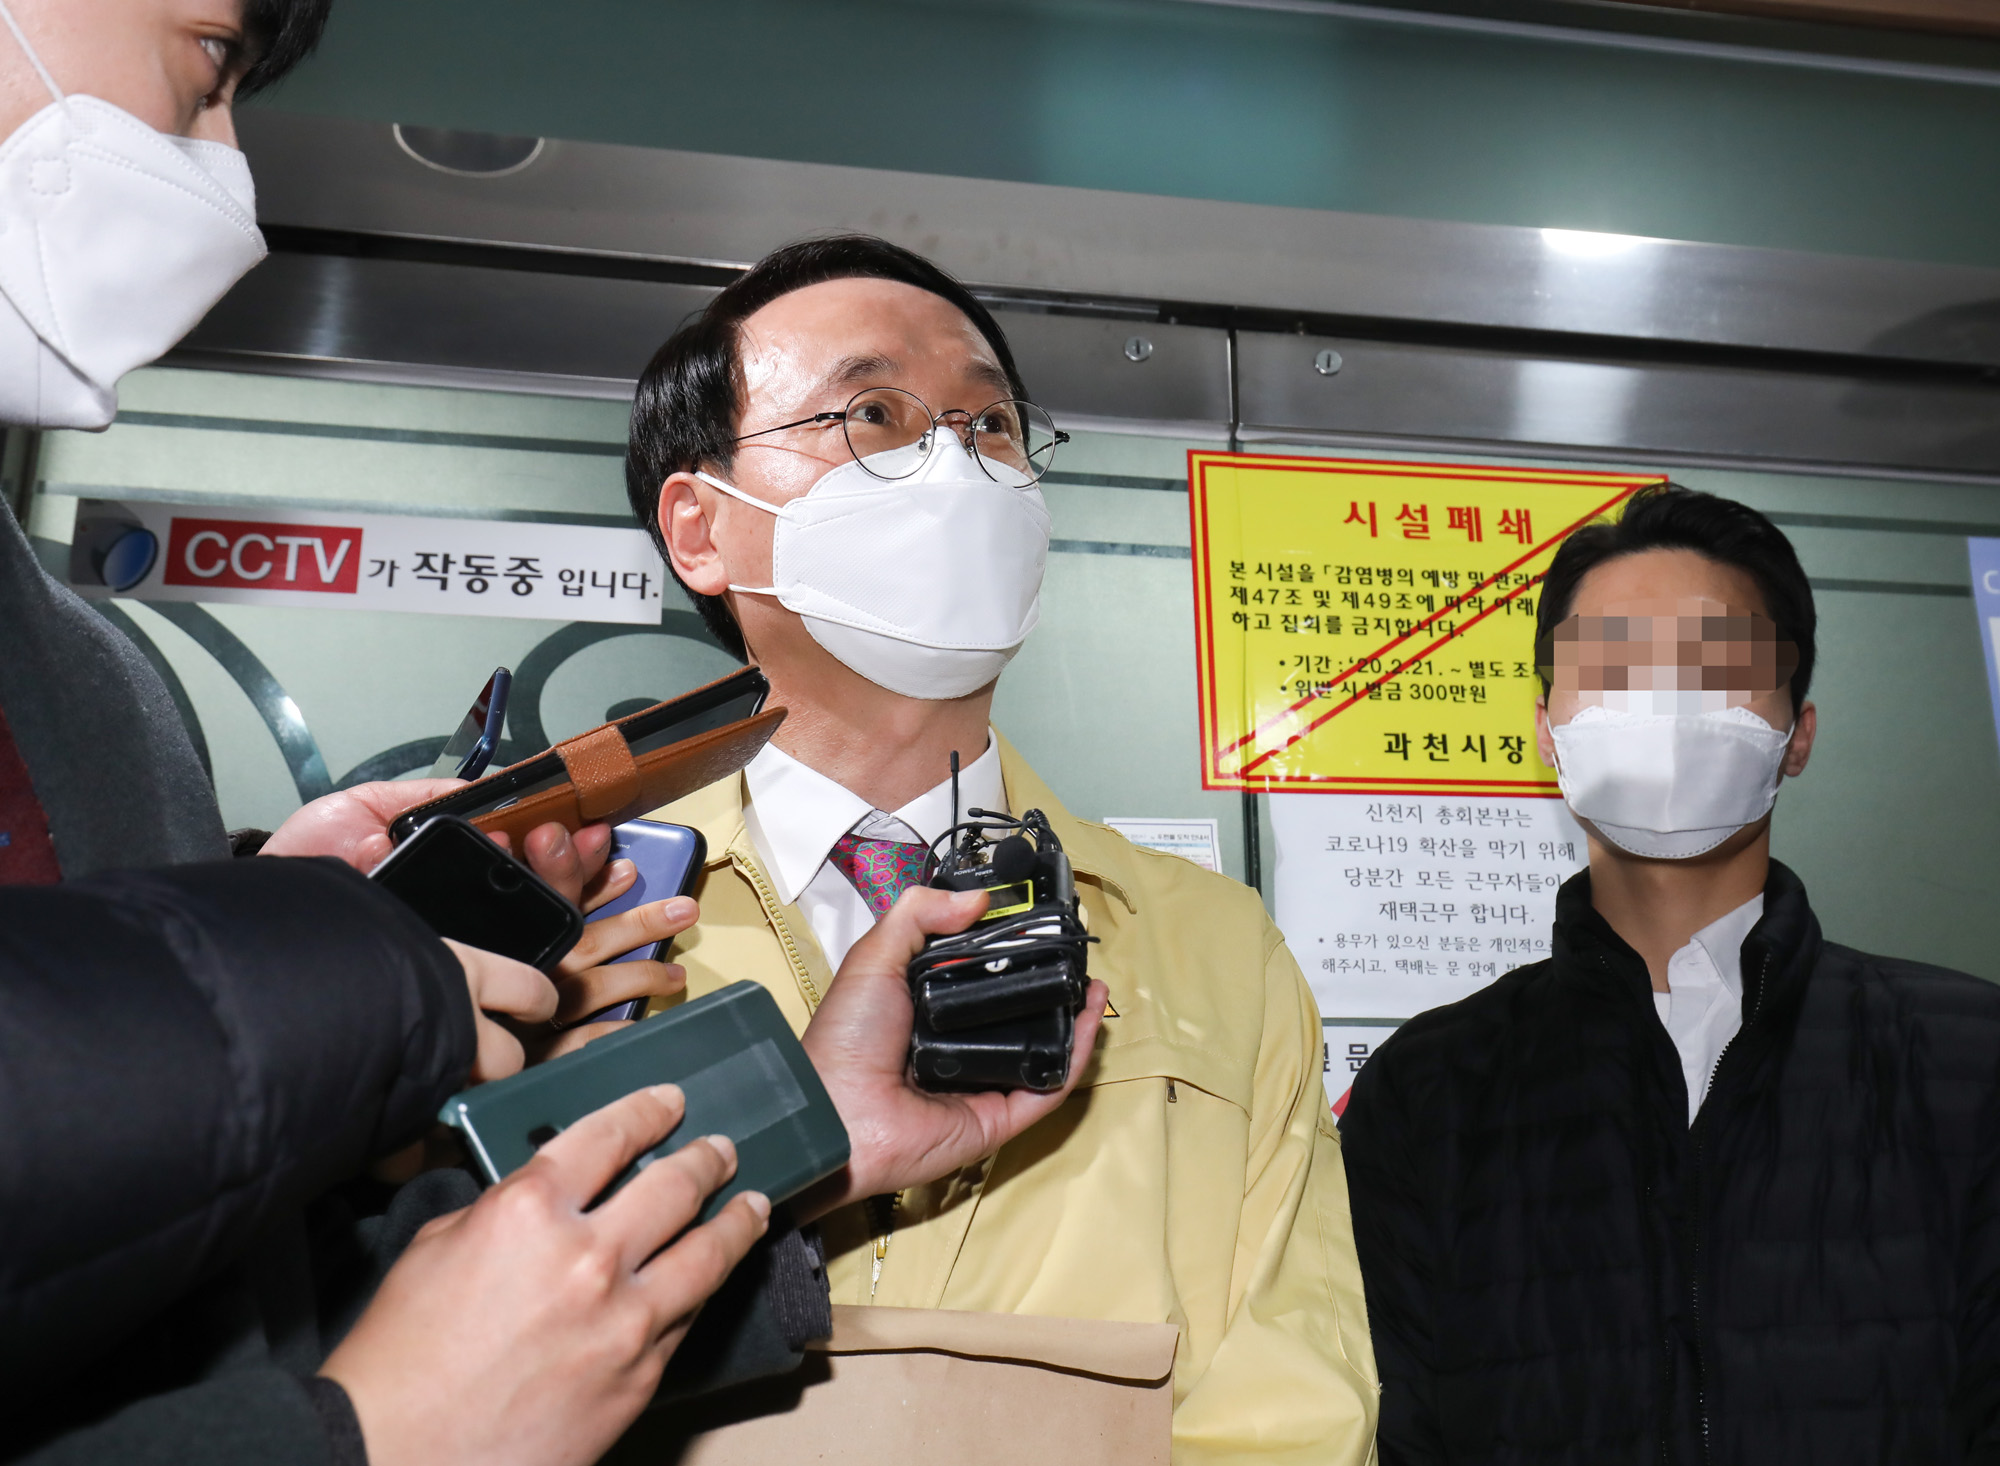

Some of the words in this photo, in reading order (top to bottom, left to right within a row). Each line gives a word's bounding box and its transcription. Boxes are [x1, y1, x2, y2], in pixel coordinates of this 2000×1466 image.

[1343, 501, 1533, 544] 시설폐쇄
[185, 531, 351, 584] CCTV
[368, 559, 399, 588] 가
[412, 552, 543, 596] 작동중
[558, 569, 659, 600] 입니다.
[1229, 561, 1247, 580] 본
[1255, 562, 1315, 583] 시설을
[1421, 569, 1460, 589] 예방
[1468, 571, 1485, 589] 및
[1230, 586, 1302, 606] 제47조
[1313, 590, 1331, 609] 및
[1341, 591, 1434, 613] 제49조에
[1445, 595, 1485, 614] 따라
[1232, 611, 1271, 631] 하고
[1281, 614, 1342, 635] 집회를
[1352, 616, 1464, 638] 금지합니다.
[1293, 655, 1331, 674] 기간
[1469, 660, 1505, 679] 별도
[1295, 680, 1332, 699] 위반
[1341, 681, 1357, 699] 시
[1366, 682, 1402, 701] 벌금
[1410, 683, 1487, 703] 300만원
[1384, 733, 1527, 764] 과천시장
[1366, 803, 1423, 824] 신천지
[1435, 805, 1533, 828] 총회본부는
[1325, 835, 1408, 855] 코로나19
[1419, 837, 1477, 859] 확산을
[1488, 840, 1525, 860] 막기
[1538, 841, 1576, 861] 위해
[1344, 867, 1404, 888] 당분간
[1416, 870, 1454, 890] 모든
[1465, 871, 1561, 893] 근무자들이
[1379, 901, 1459, 923] 재택근무
[1470, 903, 1535, 925] 합니다.
[1334, 933, 1378, 949] 용무가
[1386, 934, 1430, 951] 있으신
[1438, 936, 1482, 952] 분들은
[1395, 959, 1438, 976] 택배는
[1446, 961, 1461, 976] 문
[1469, 962, 1497, 977] 앞에
